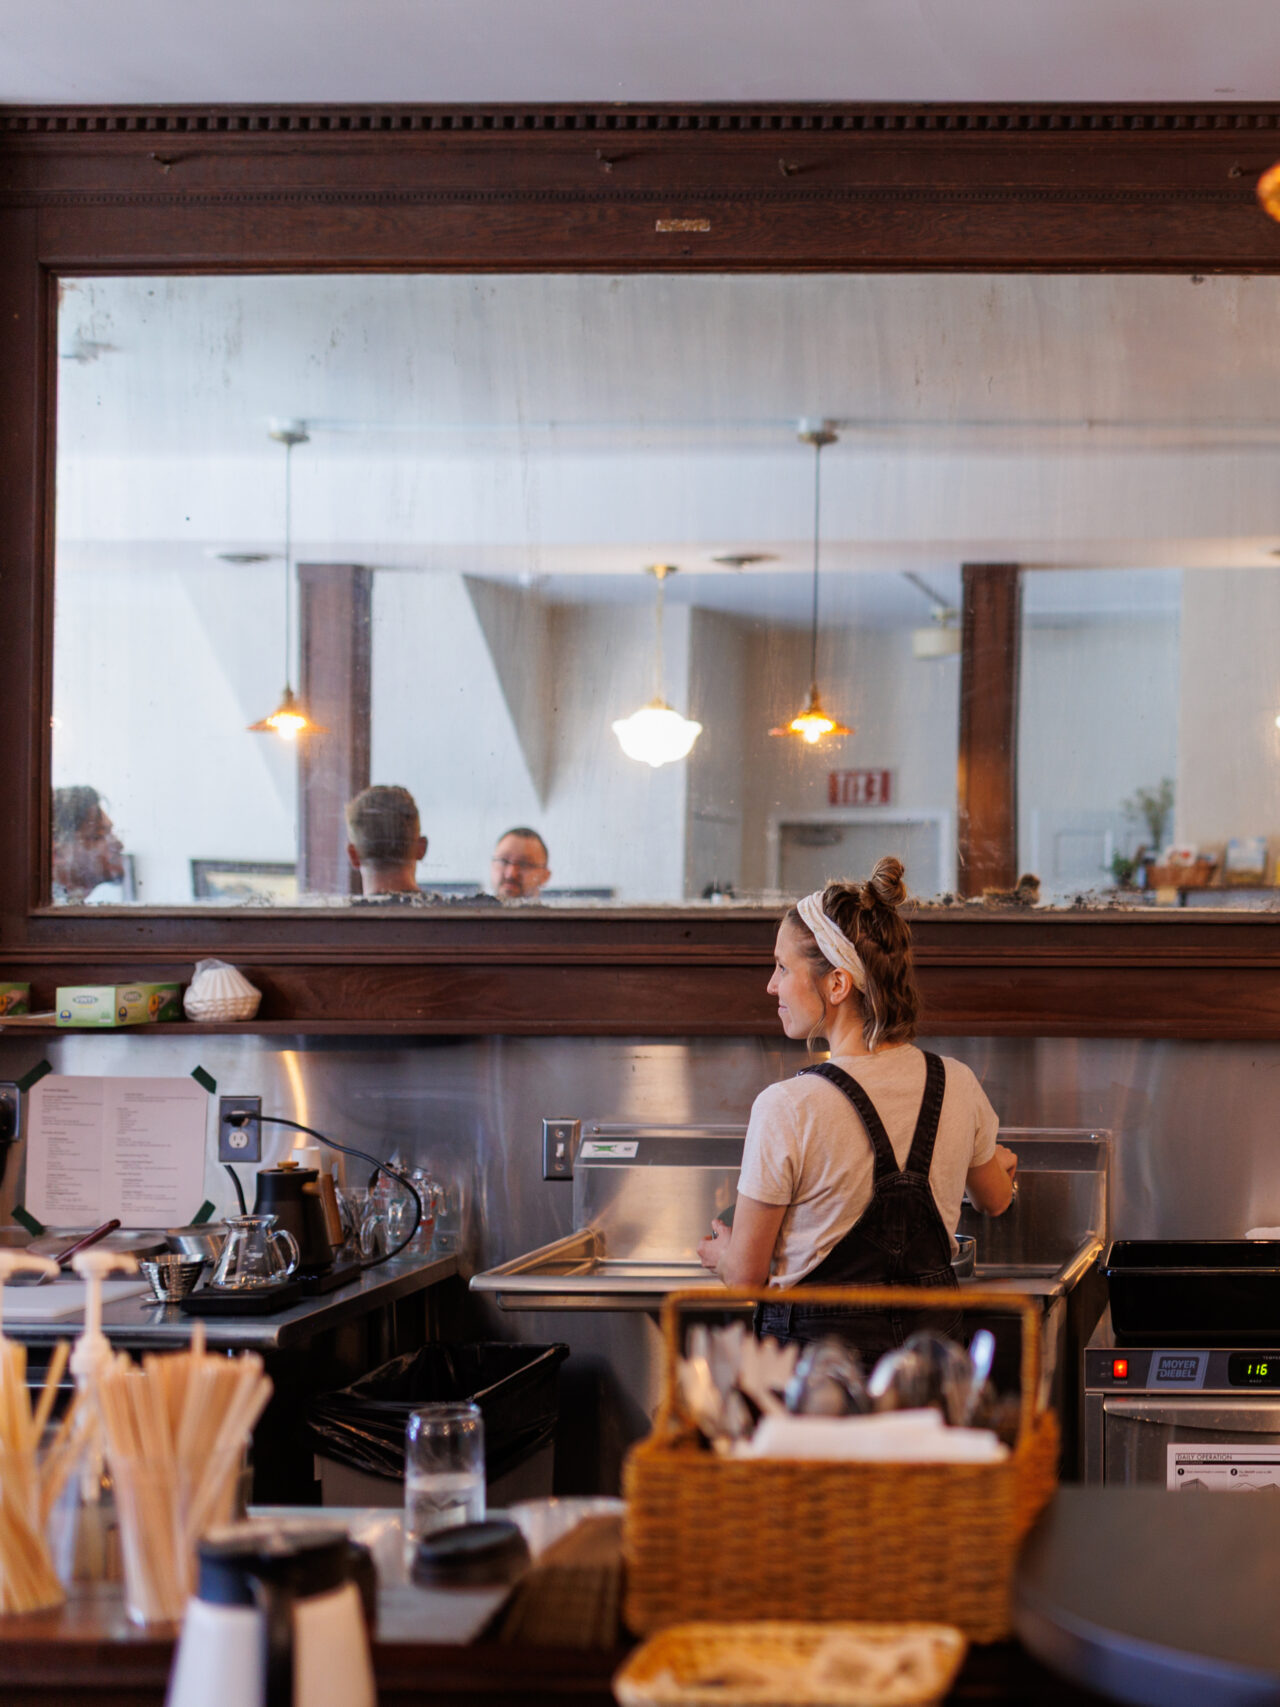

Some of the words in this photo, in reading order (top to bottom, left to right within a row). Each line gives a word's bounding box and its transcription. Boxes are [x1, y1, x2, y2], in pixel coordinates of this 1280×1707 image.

[1162, 1360, 1196, 1369] MOYER
[1159, 1369, 1194, 1378] DIEBEL
[1247, 1363, 1268, 1376] 116
